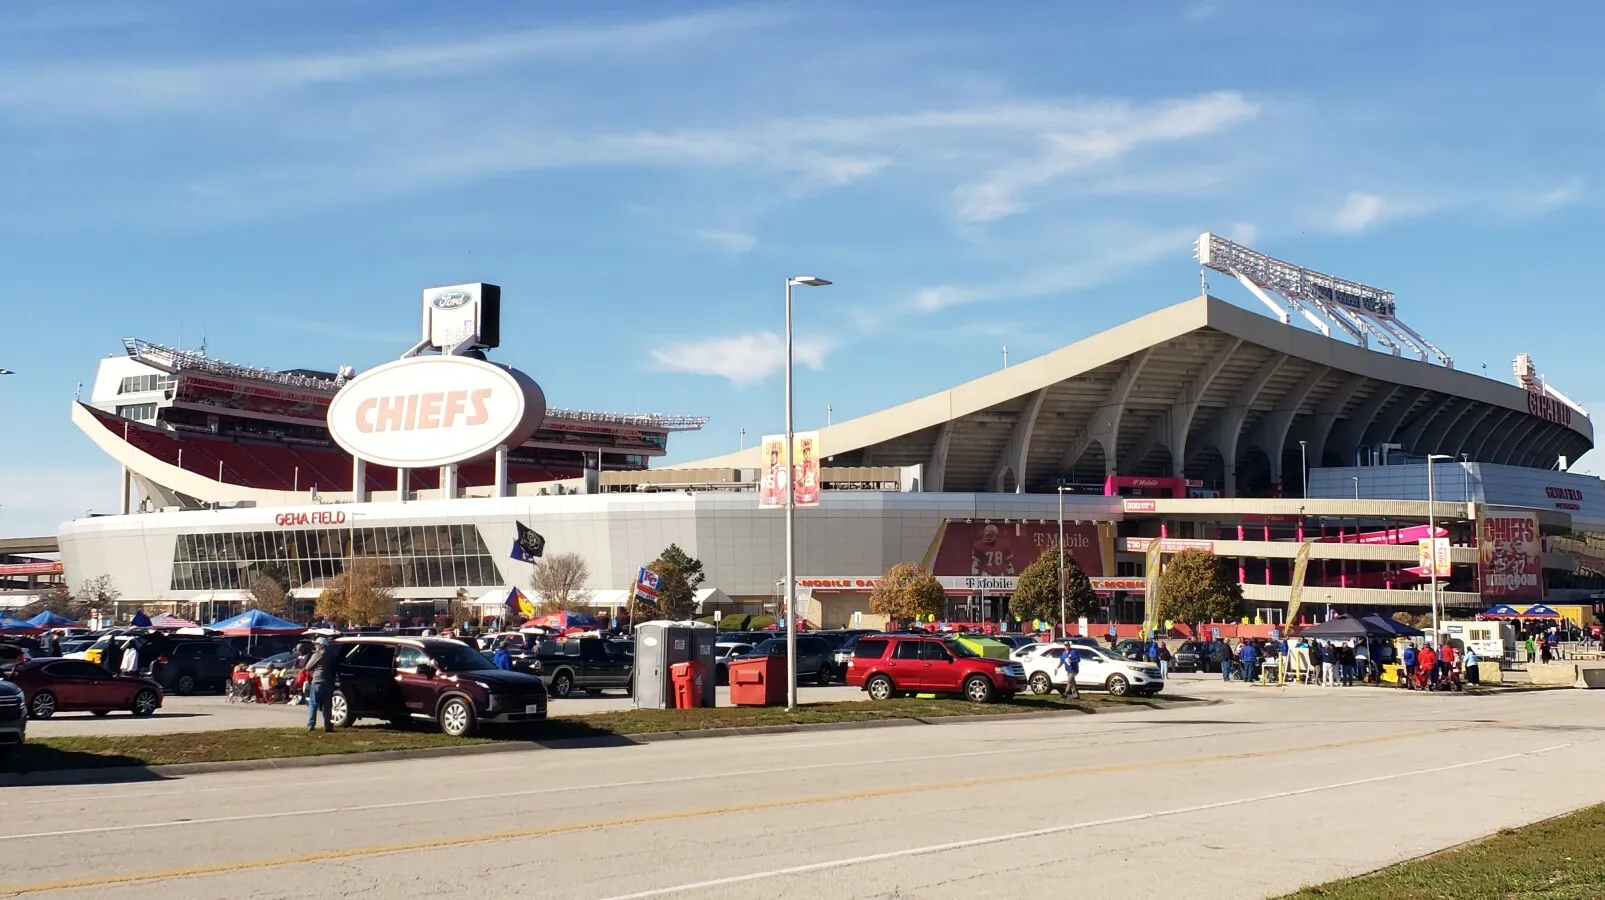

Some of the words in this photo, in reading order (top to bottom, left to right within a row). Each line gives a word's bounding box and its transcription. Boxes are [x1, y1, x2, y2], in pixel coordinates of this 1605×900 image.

[439, 292, 464, 307] Ford
[355, 388, 492, 433] CHIEFS
[275, 512, 309, 526] GEHA
[311, 511, 345, 525] FIELD
[1483, 518, 1535, 543] CHIEFS
[984, 551, 1003, 567] 78
[644, 570, 657, 587] KC
